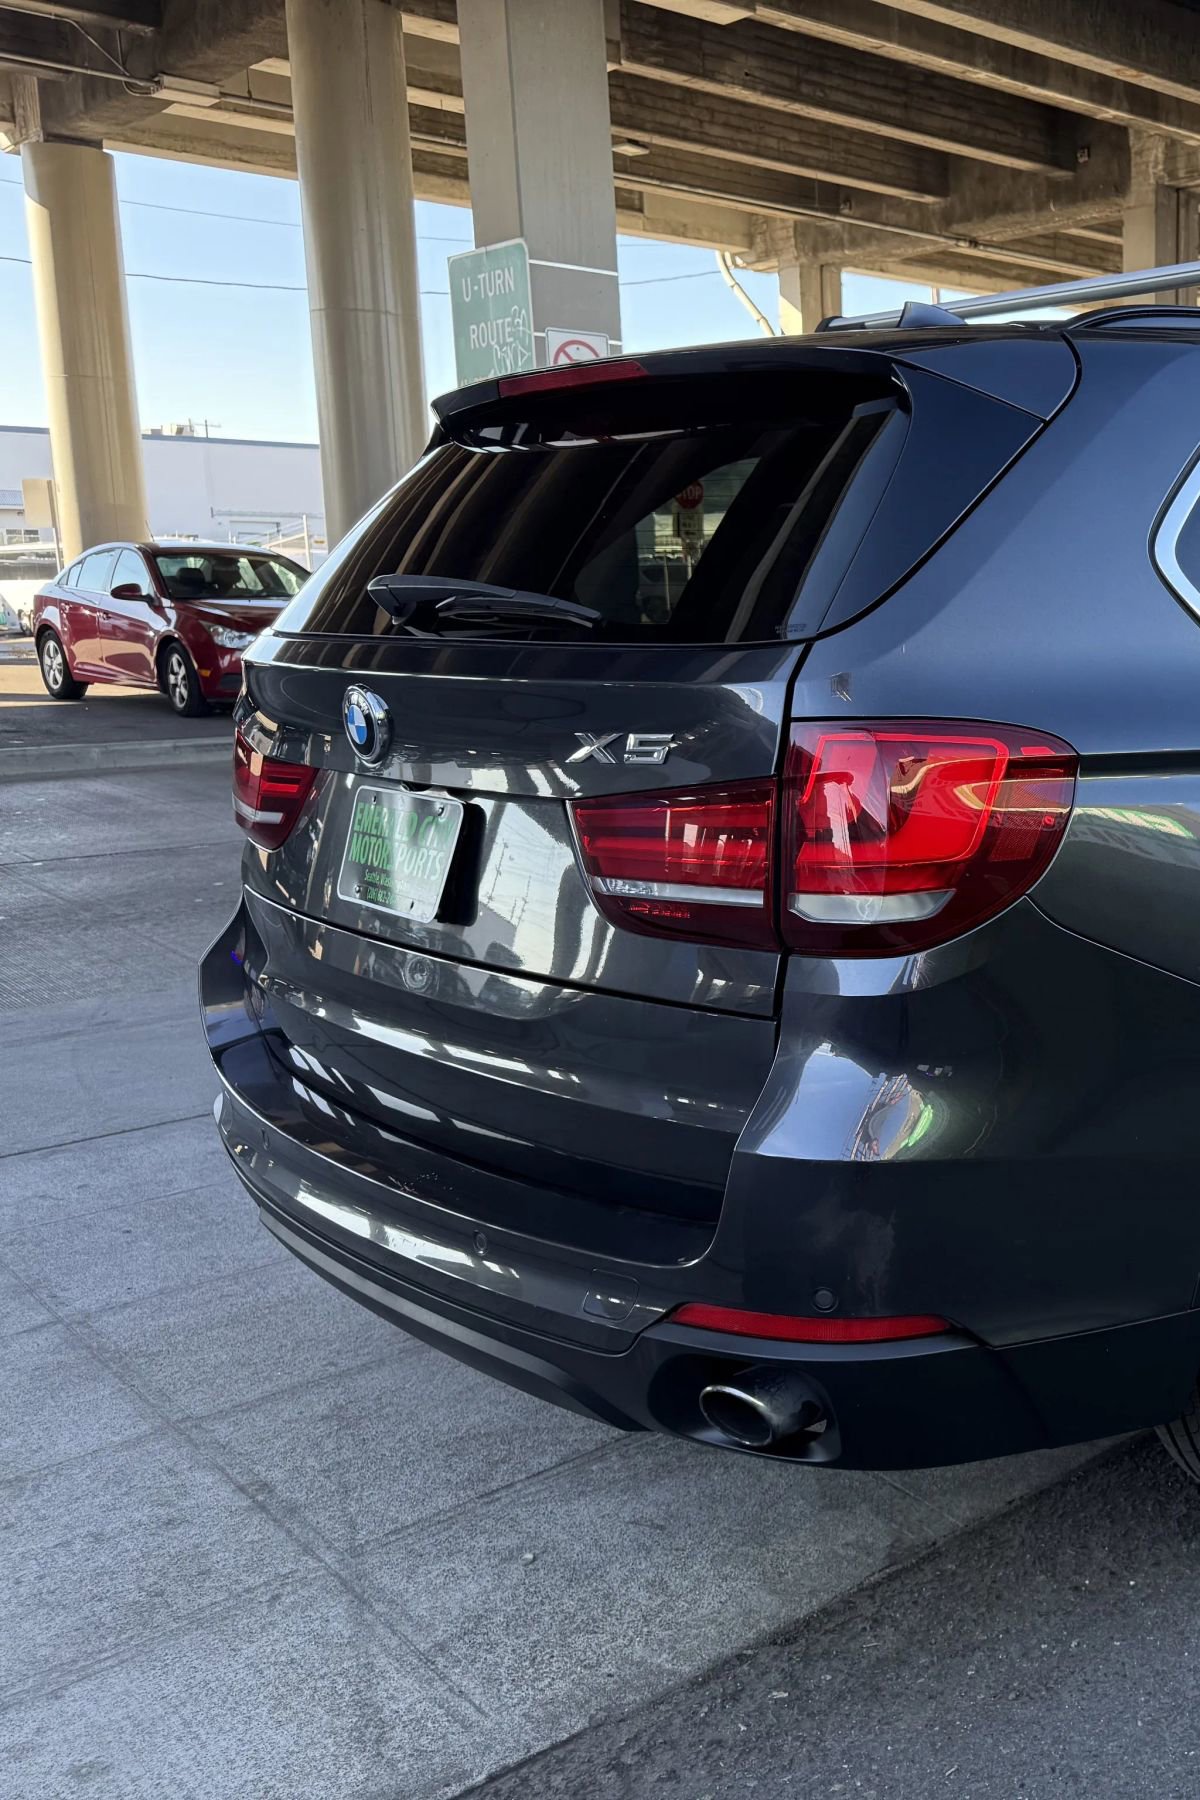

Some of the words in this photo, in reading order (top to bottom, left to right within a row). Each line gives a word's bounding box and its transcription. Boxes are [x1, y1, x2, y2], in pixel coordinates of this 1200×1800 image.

[462, 266, 515, 302] U-TURN
[469, 316, 515, 349] ROUTE
[565, 732, 674, 764] X5
[354, 802, 418, 841] EMERLD
